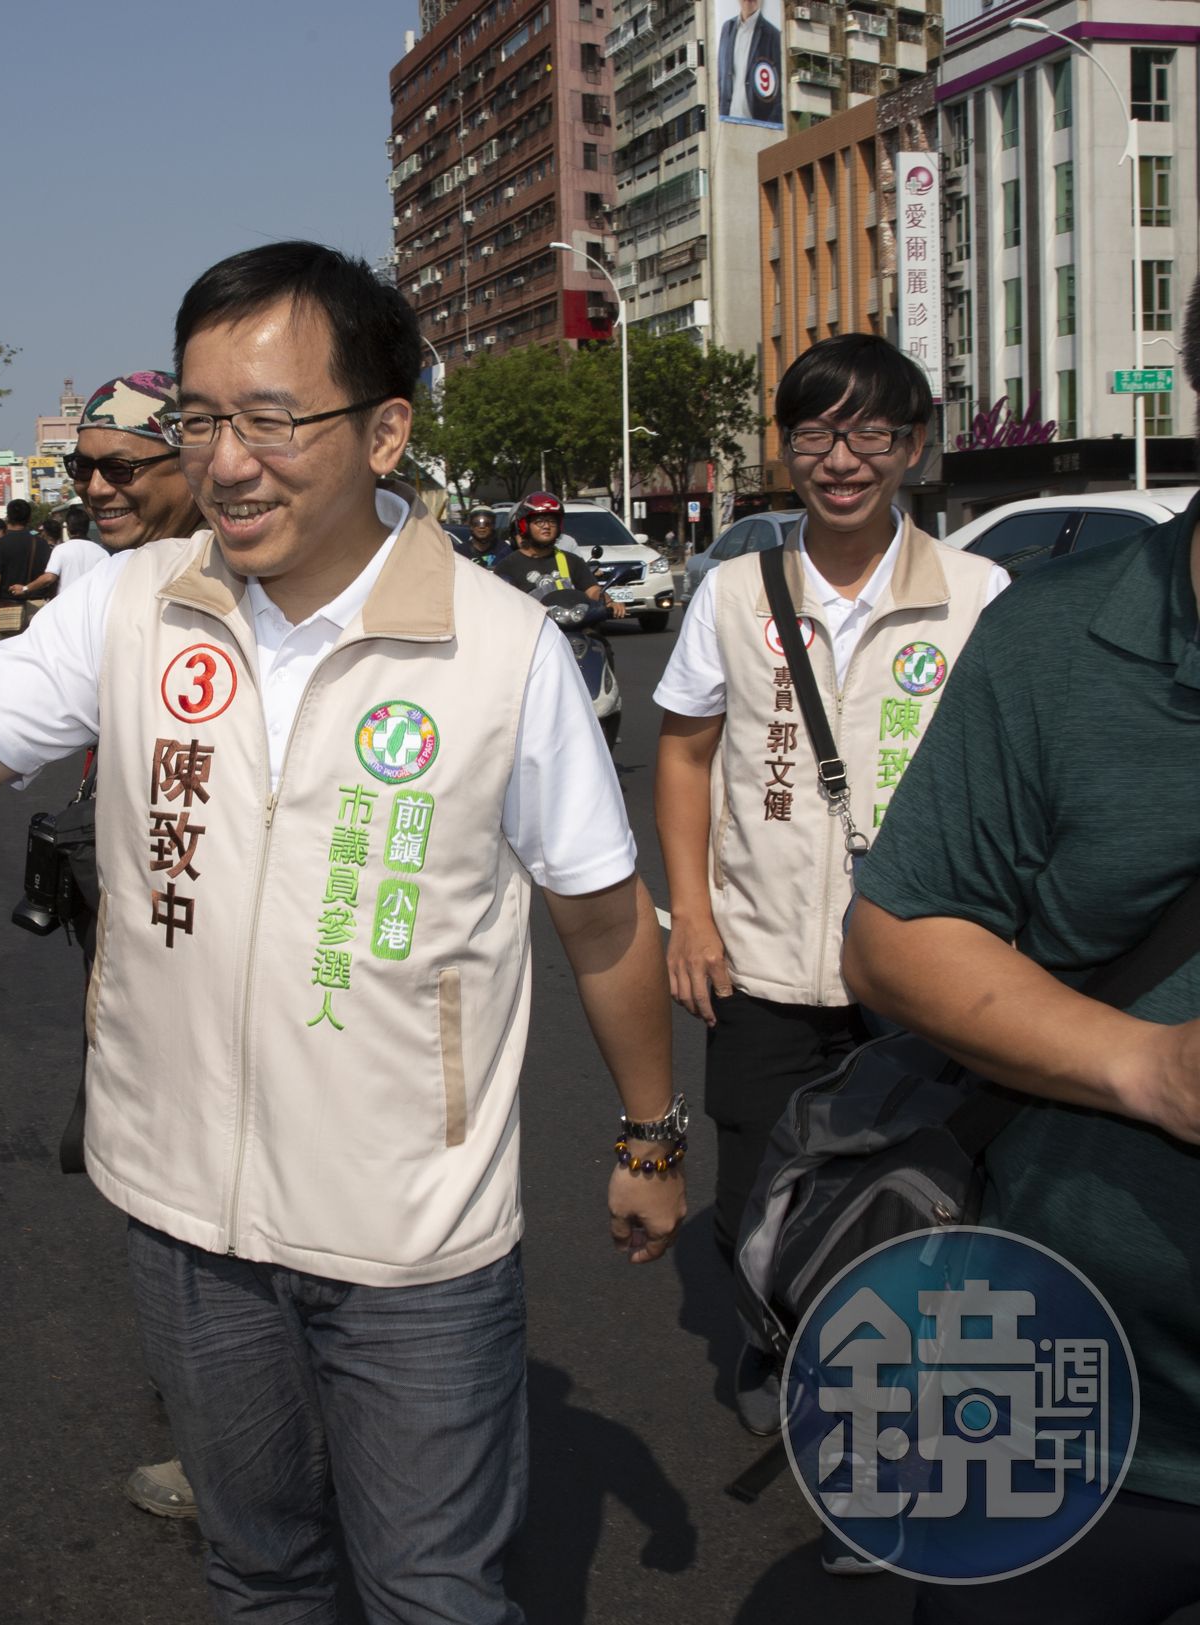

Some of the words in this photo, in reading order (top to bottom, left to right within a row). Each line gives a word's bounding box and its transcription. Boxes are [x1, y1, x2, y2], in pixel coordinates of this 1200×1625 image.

[759, 68, 770, 92] 9
[905, 203, 928, 360] 愛爾麗診所
[177, 653, 217, 713] 3
[773, 666, 796, 713] 專員
[764, 721, 798, 822] 郭文健
[150, 737, 215, 948] 陳致中
[388, 795, 428, 869] 前鎮
[306, 784, 380, 1032] 市議員參選人
[376, 888, 414, 951] 小港
